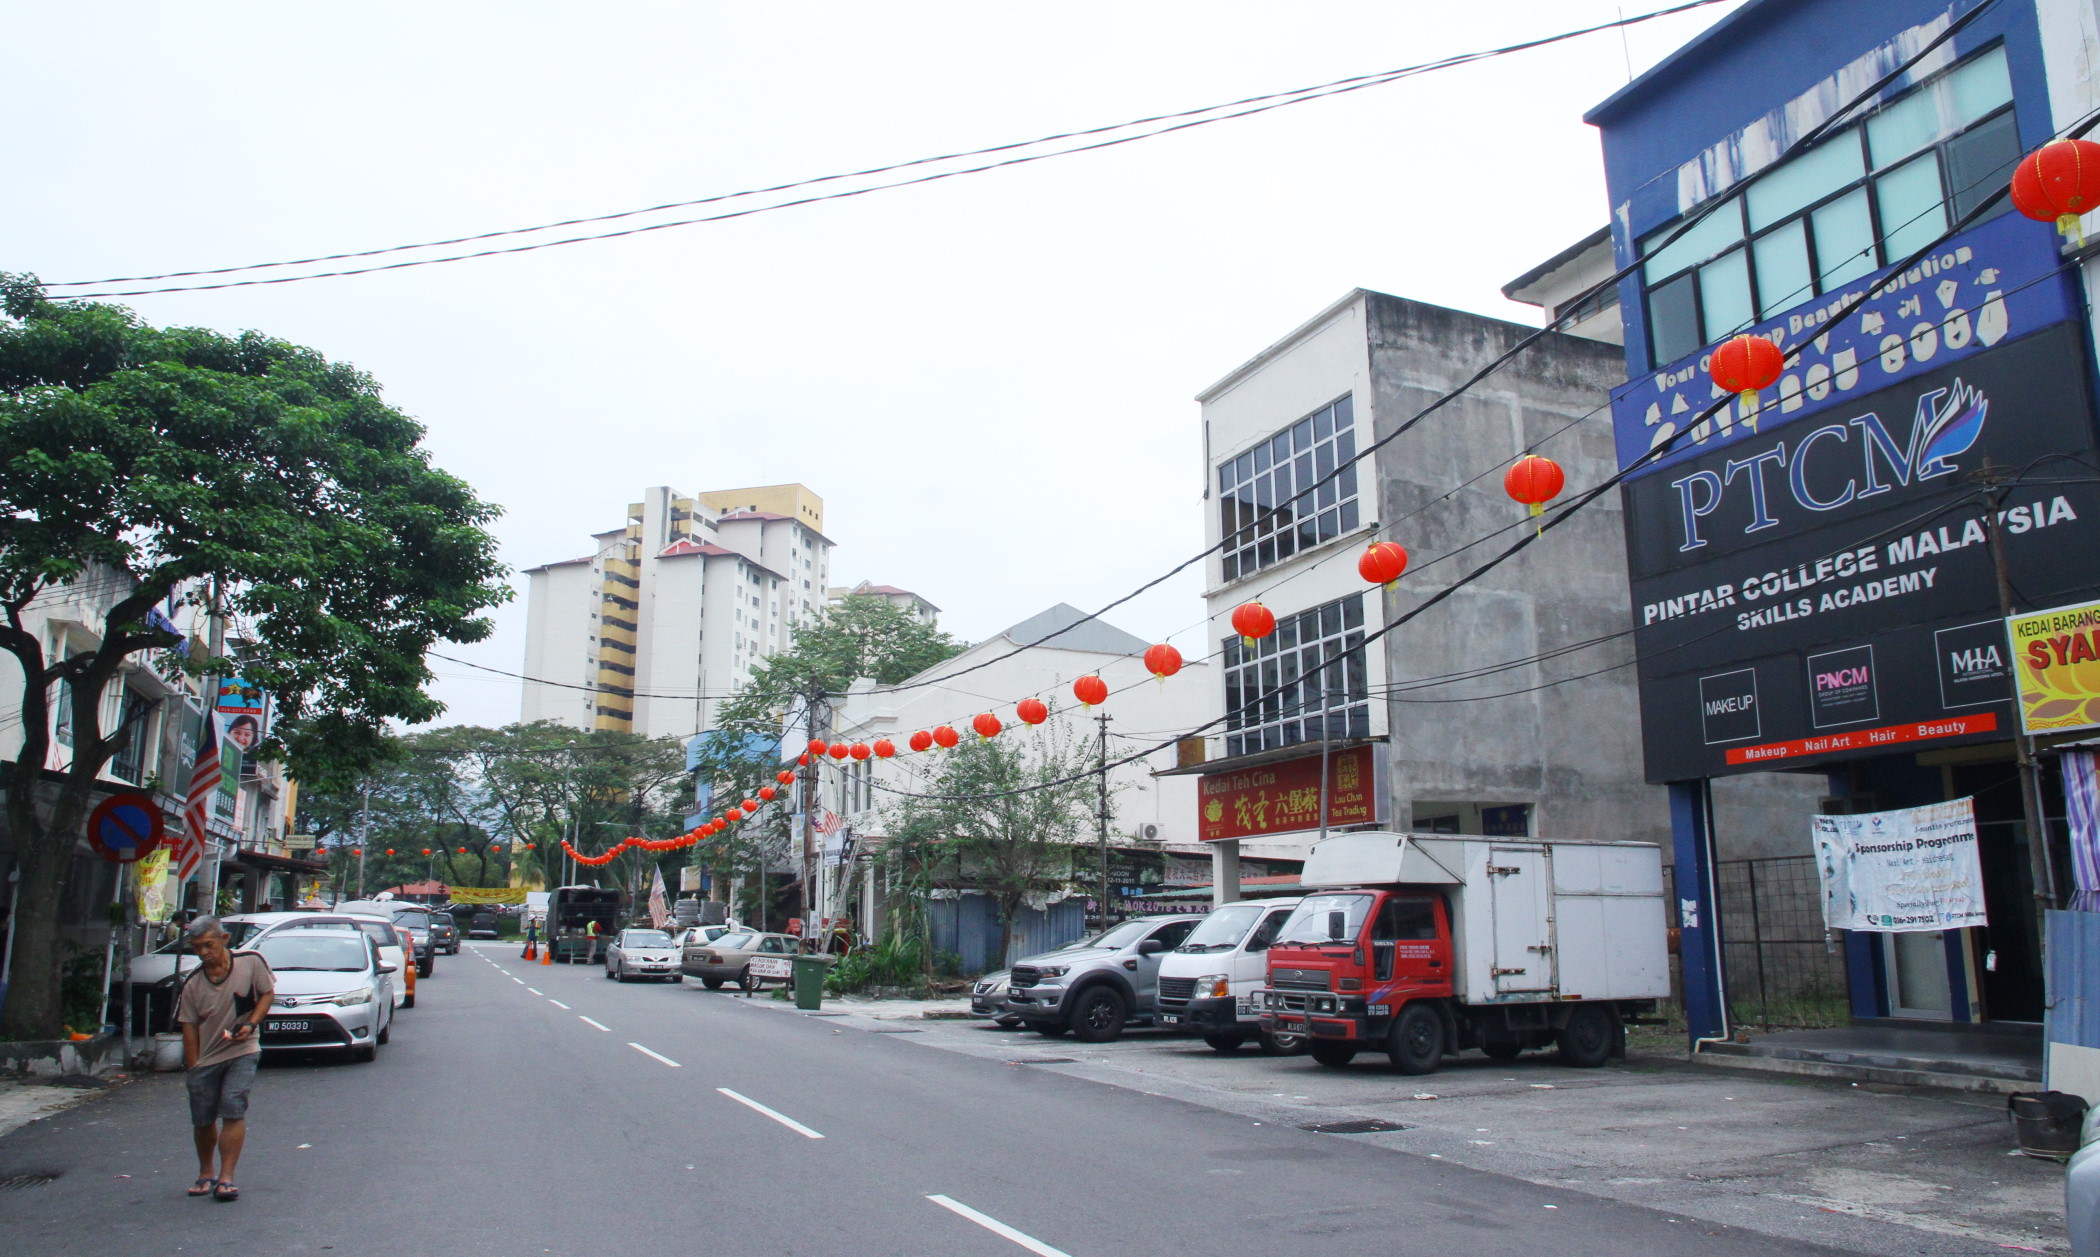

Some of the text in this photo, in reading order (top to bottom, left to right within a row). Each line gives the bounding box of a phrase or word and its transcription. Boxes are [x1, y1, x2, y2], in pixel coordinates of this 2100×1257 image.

[1655, 365, 1695, 393] Your
[1671, 386, 1959, 552] PTCM
[1643, 582, 1735, 626] PINTAR
[1742, 545, 1879, 601] COLLEGE
[1737, 566, 1938, 632] SKILLS ACADEMY
[2017, 618, 2052, 638] KEDAI
[2028, 629, 2100, 671] SYA
[1816, 666, 1870, 692] PNCM
[1706, 694, 1754, 716] MAKE UP
[1745, 721, 1966, 760] Makeup Nail Art Hair Beauty
[1203, 772, 1276, 796] Kedai Teh Cina
[1332, 808, 1343, 817] Tea
[268, 1022, 279, 1031] WD
[281, 1021, 302, 1031] 5033
